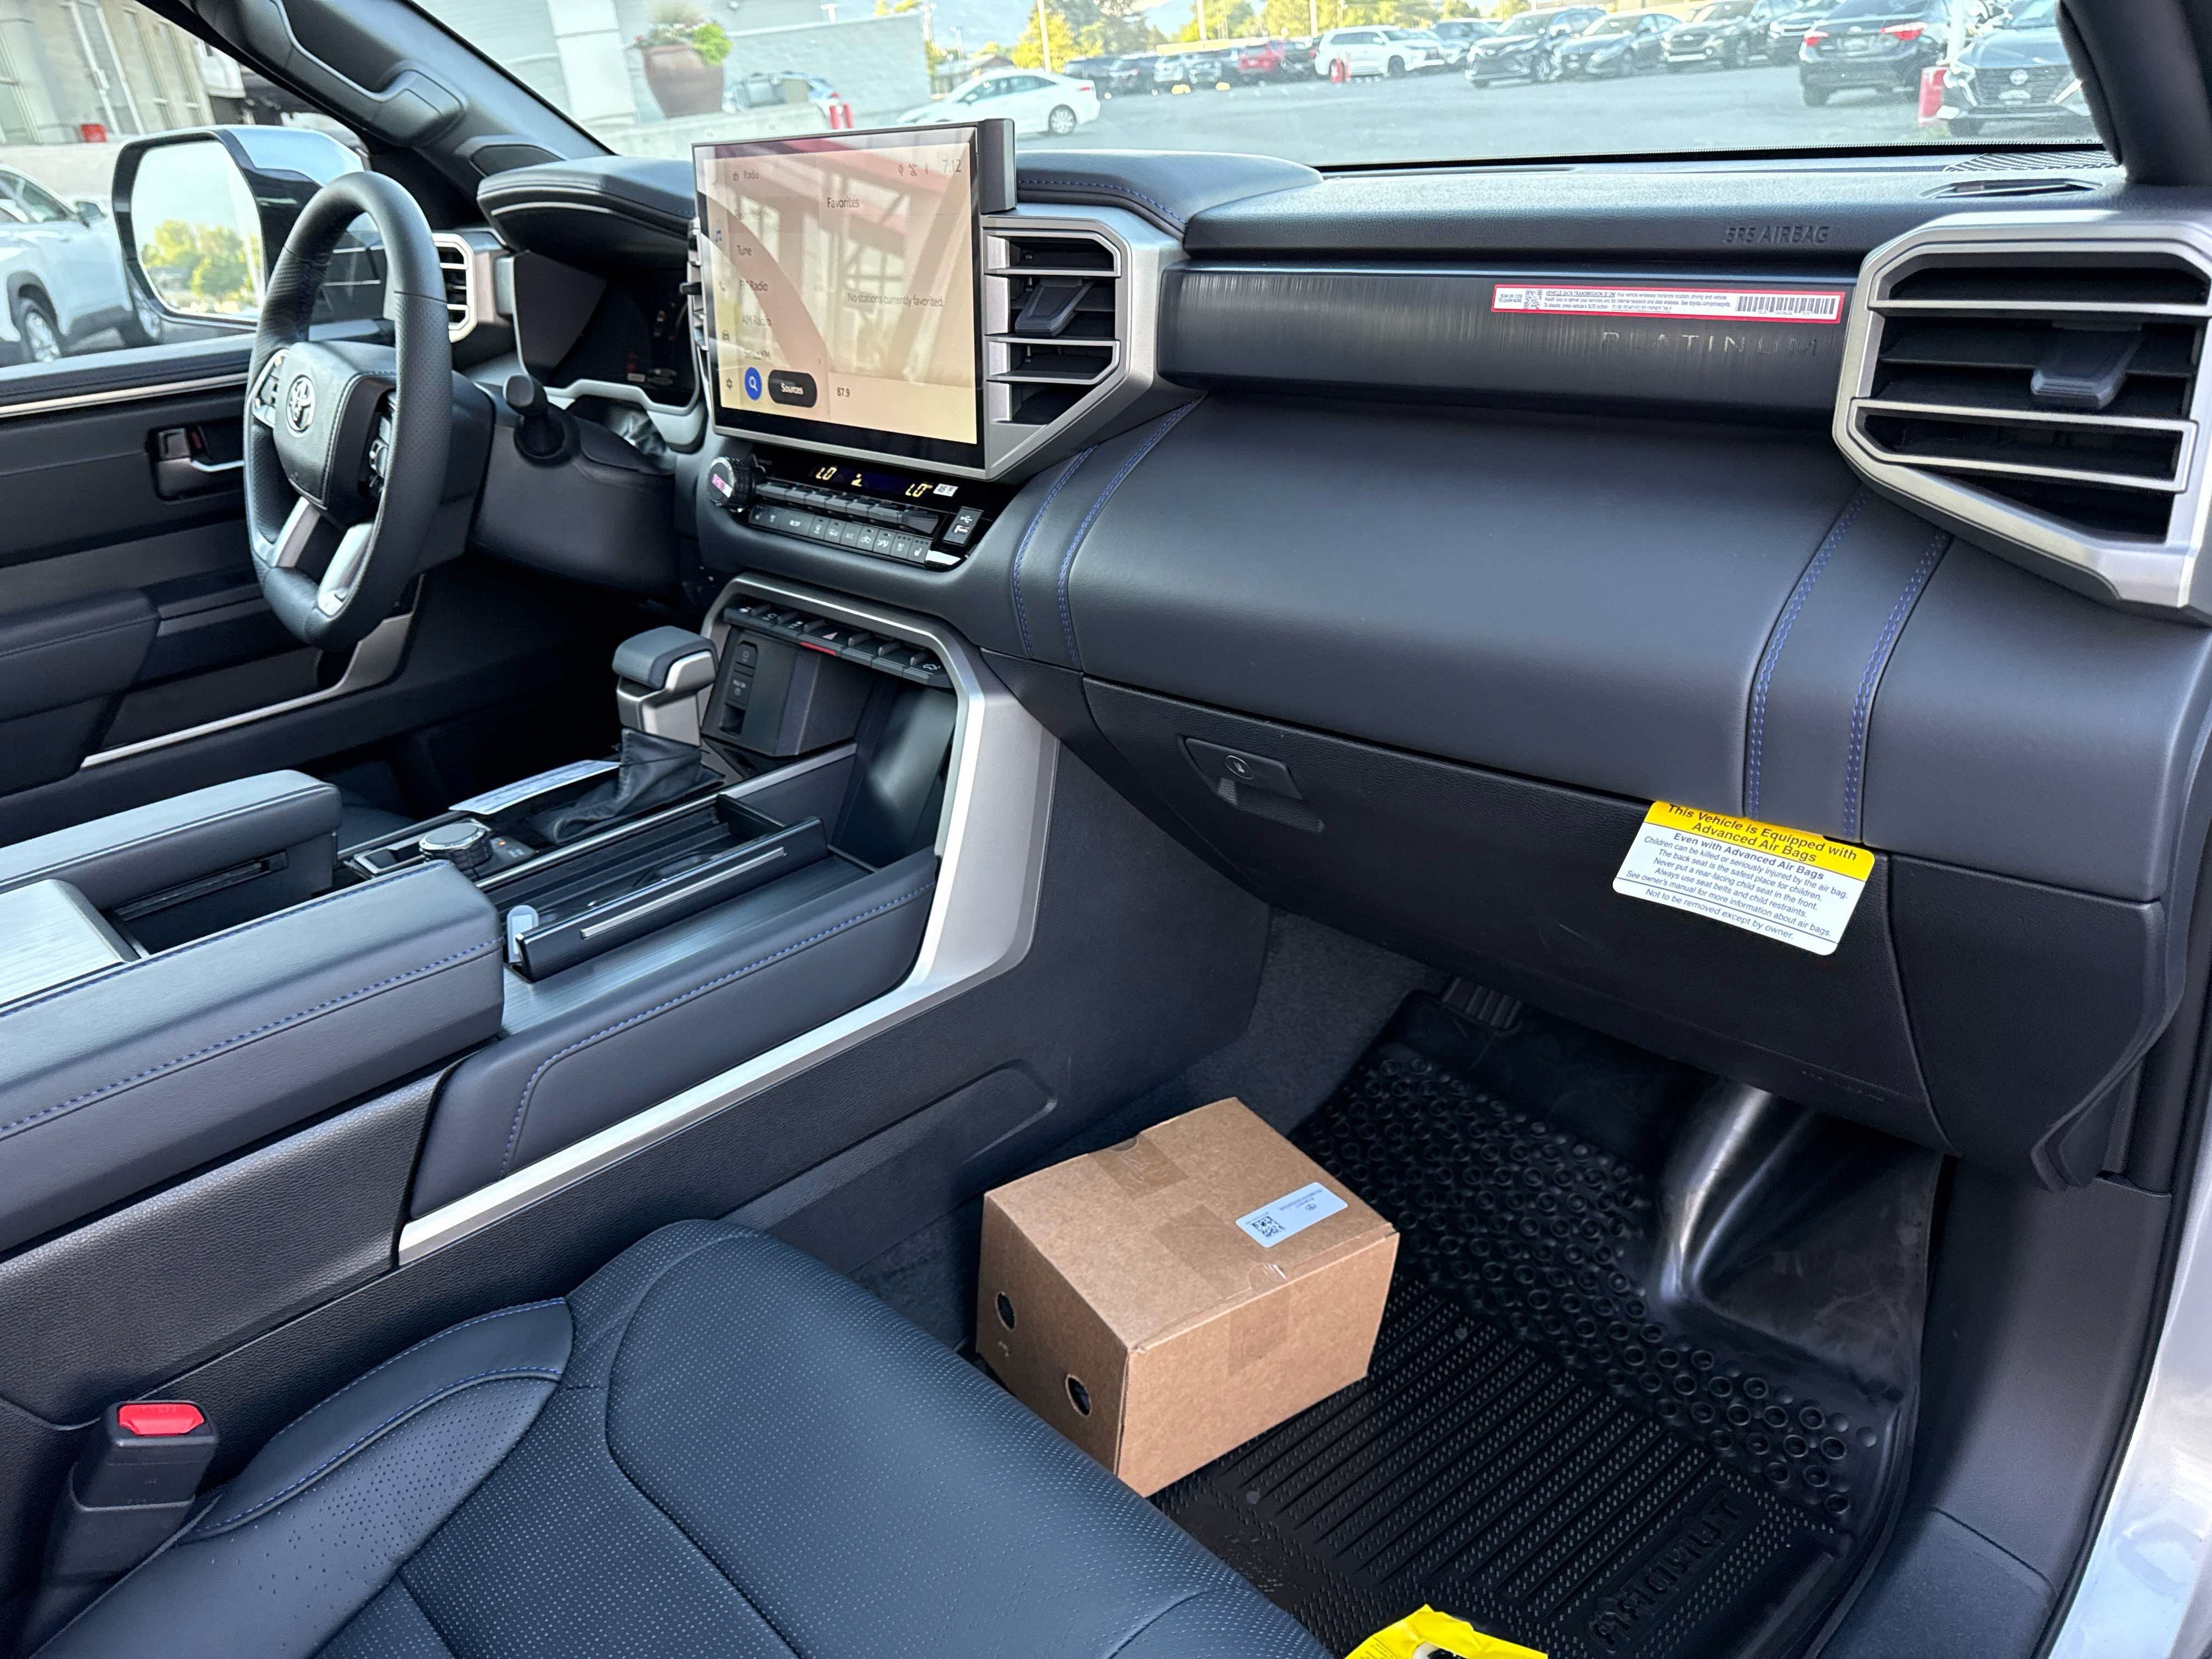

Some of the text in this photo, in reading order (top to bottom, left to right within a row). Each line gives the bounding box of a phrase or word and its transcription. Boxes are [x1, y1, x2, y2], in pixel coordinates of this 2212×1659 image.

[943, 159, 962, 173] 7:12
[827, 197, 860, 208] Favorites
[737, 245, 752, 256] Tune
[1759, 225, 1829, 245] AIRBAG
[750, 281, 768, 291] Radio
[847, 292, 856, 302] No
[857, 294, 883, 303] stations
[884, 294, 912, 307] currently
[1600, 331, 1818, 356] PLATINUM
[781, 383, 804, 395] Sources
[1667, 804, 1857, 861] This Vehicle is Equipped with
[1691, 822, 1817, 862] Advanced Air Bags
[1644, 836, 1673, 848] Children
[1700, 849, 1720, 860] killed
[1730, 859, 1763, 874] seriously
[1765, 867, 1792, 881] injured
[1792, 875, 1803, 885] by
[1804, 878, 1817, 888] the
[1818, 884, 1830, 892] air
[1831, 887, 1848, 899] bag.
[1658, 849, 1672, 858] The
[1673, 853, 1690, 862] back
[1691, 857, 1708, 867] seat
[1717, 864, 1729, 873] the
[1730, 868, 1754, 881] safest
[1754, 876, 1775, 887] place
[1777, 881, 1788, 890] for
[1789, 887, 1821, 901] children.
[1673, 833, 1824, 880] Even with Advanced Air Bags
[1626, 870, 1640, 879] See
[1641, 876, 1668, 886] owner's
[1669, 881, 1696, 893] manual
[1708, 893, 1729, 903] more
[1729, 898, 1772, 917] information
[1773, 912, 1797, 925] about
[1797, 920, 1809, 928] air
[1809, 923, 1831, 936] bags.
[1654, 857, 1675, 868] Never
[1695, 869, 1735, 885] rear-facing
[1736, 879, 1755, 890] child
[1756, 886, 1773, 896] seat
[1783, 894, 1796, 903] the
[1797, 898, 1818, 910] front.
[1655, 867, 1680, 879] Always
[1696, 879, 1712, 889] seat
[1713, 883, 1732, 894] belts
[1733, 890, 1749, 899] and
[1749, 894, 1768, 905] child
[1769, 900, 1807, 917] restraints.
[1645, 888, 1661, 899] Not
[1671, 895, 1683, 904] be
[1683, 899, 1721, 915] removed
[1722, 911, 1751, 924] except
[1752, 919, 1764, 929] by
[1765, 924, 1794, 940] owner.
